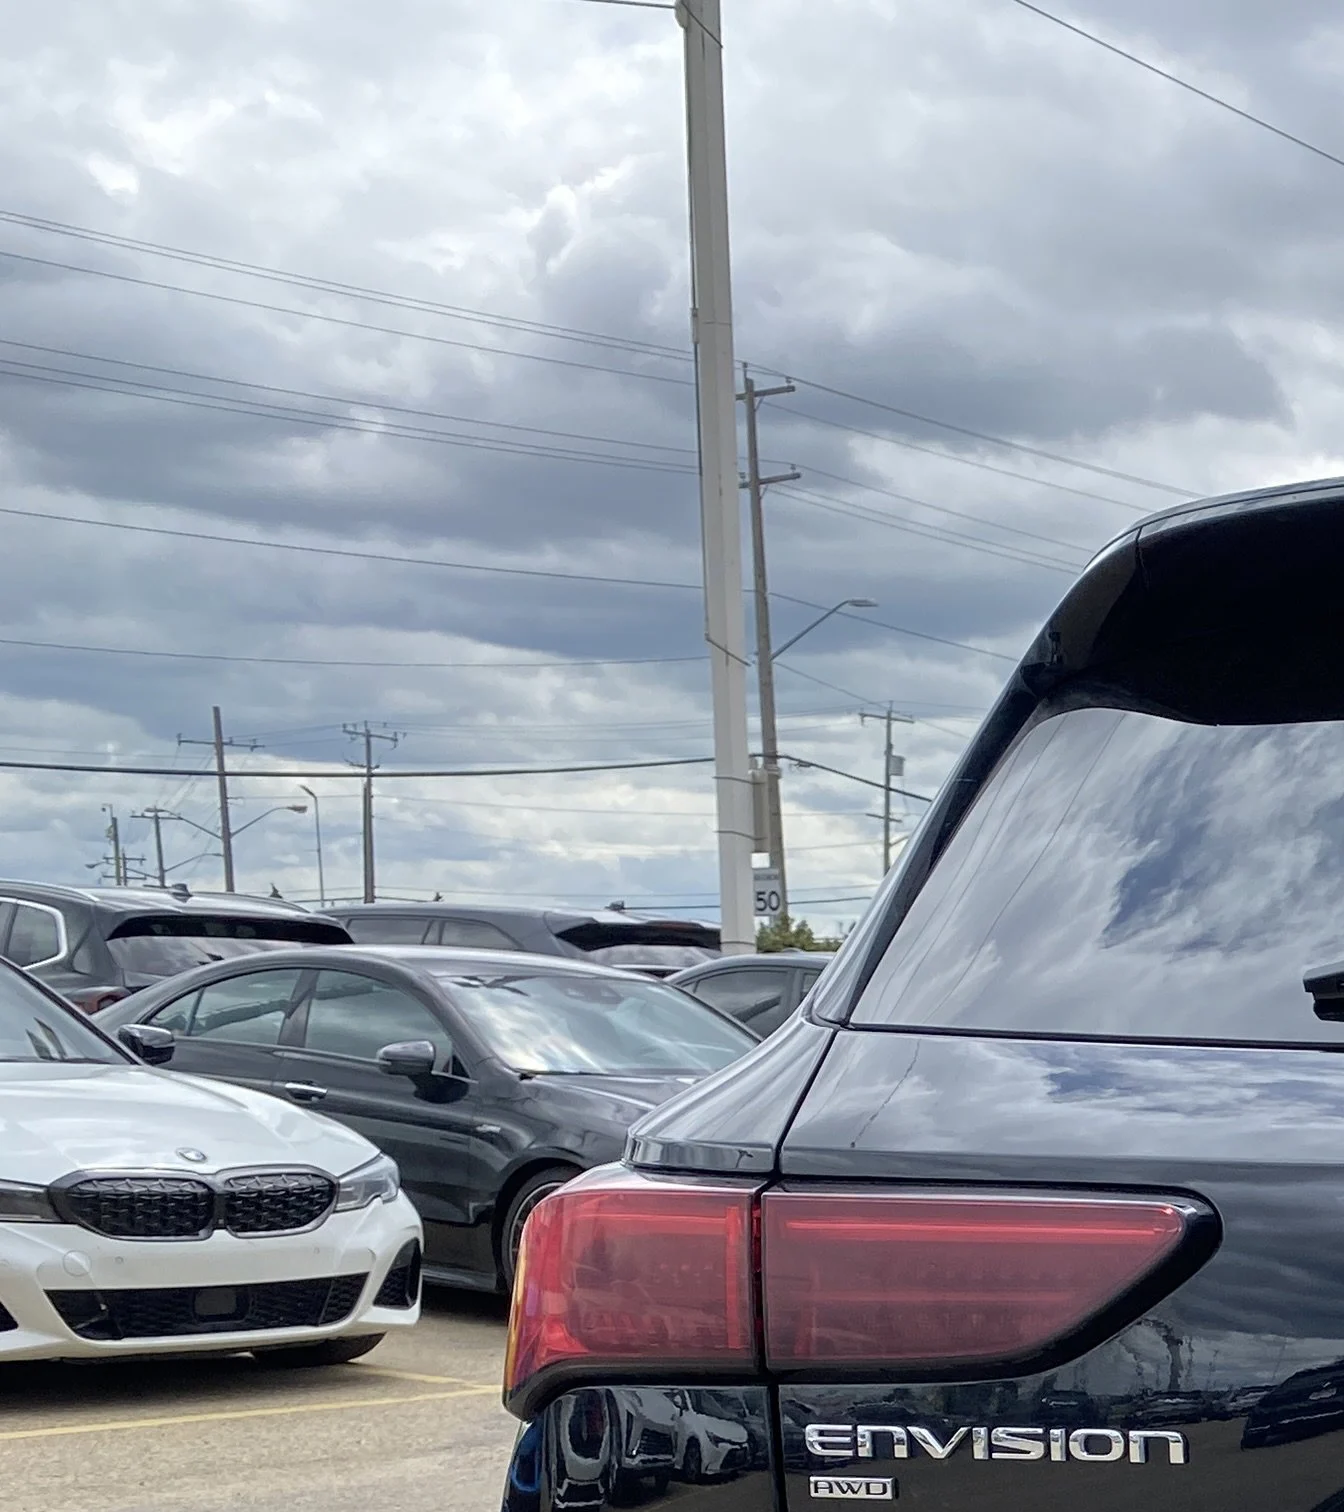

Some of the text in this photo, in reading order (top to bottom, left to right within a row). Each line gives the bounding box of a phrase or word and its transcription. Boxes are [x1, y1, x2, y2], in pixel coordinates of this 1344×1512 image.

[756, 890, 780, 912] 50
[804, 1423, 1187, 1464] ENVISION
[813, 1480, 888, 1496] AWD
